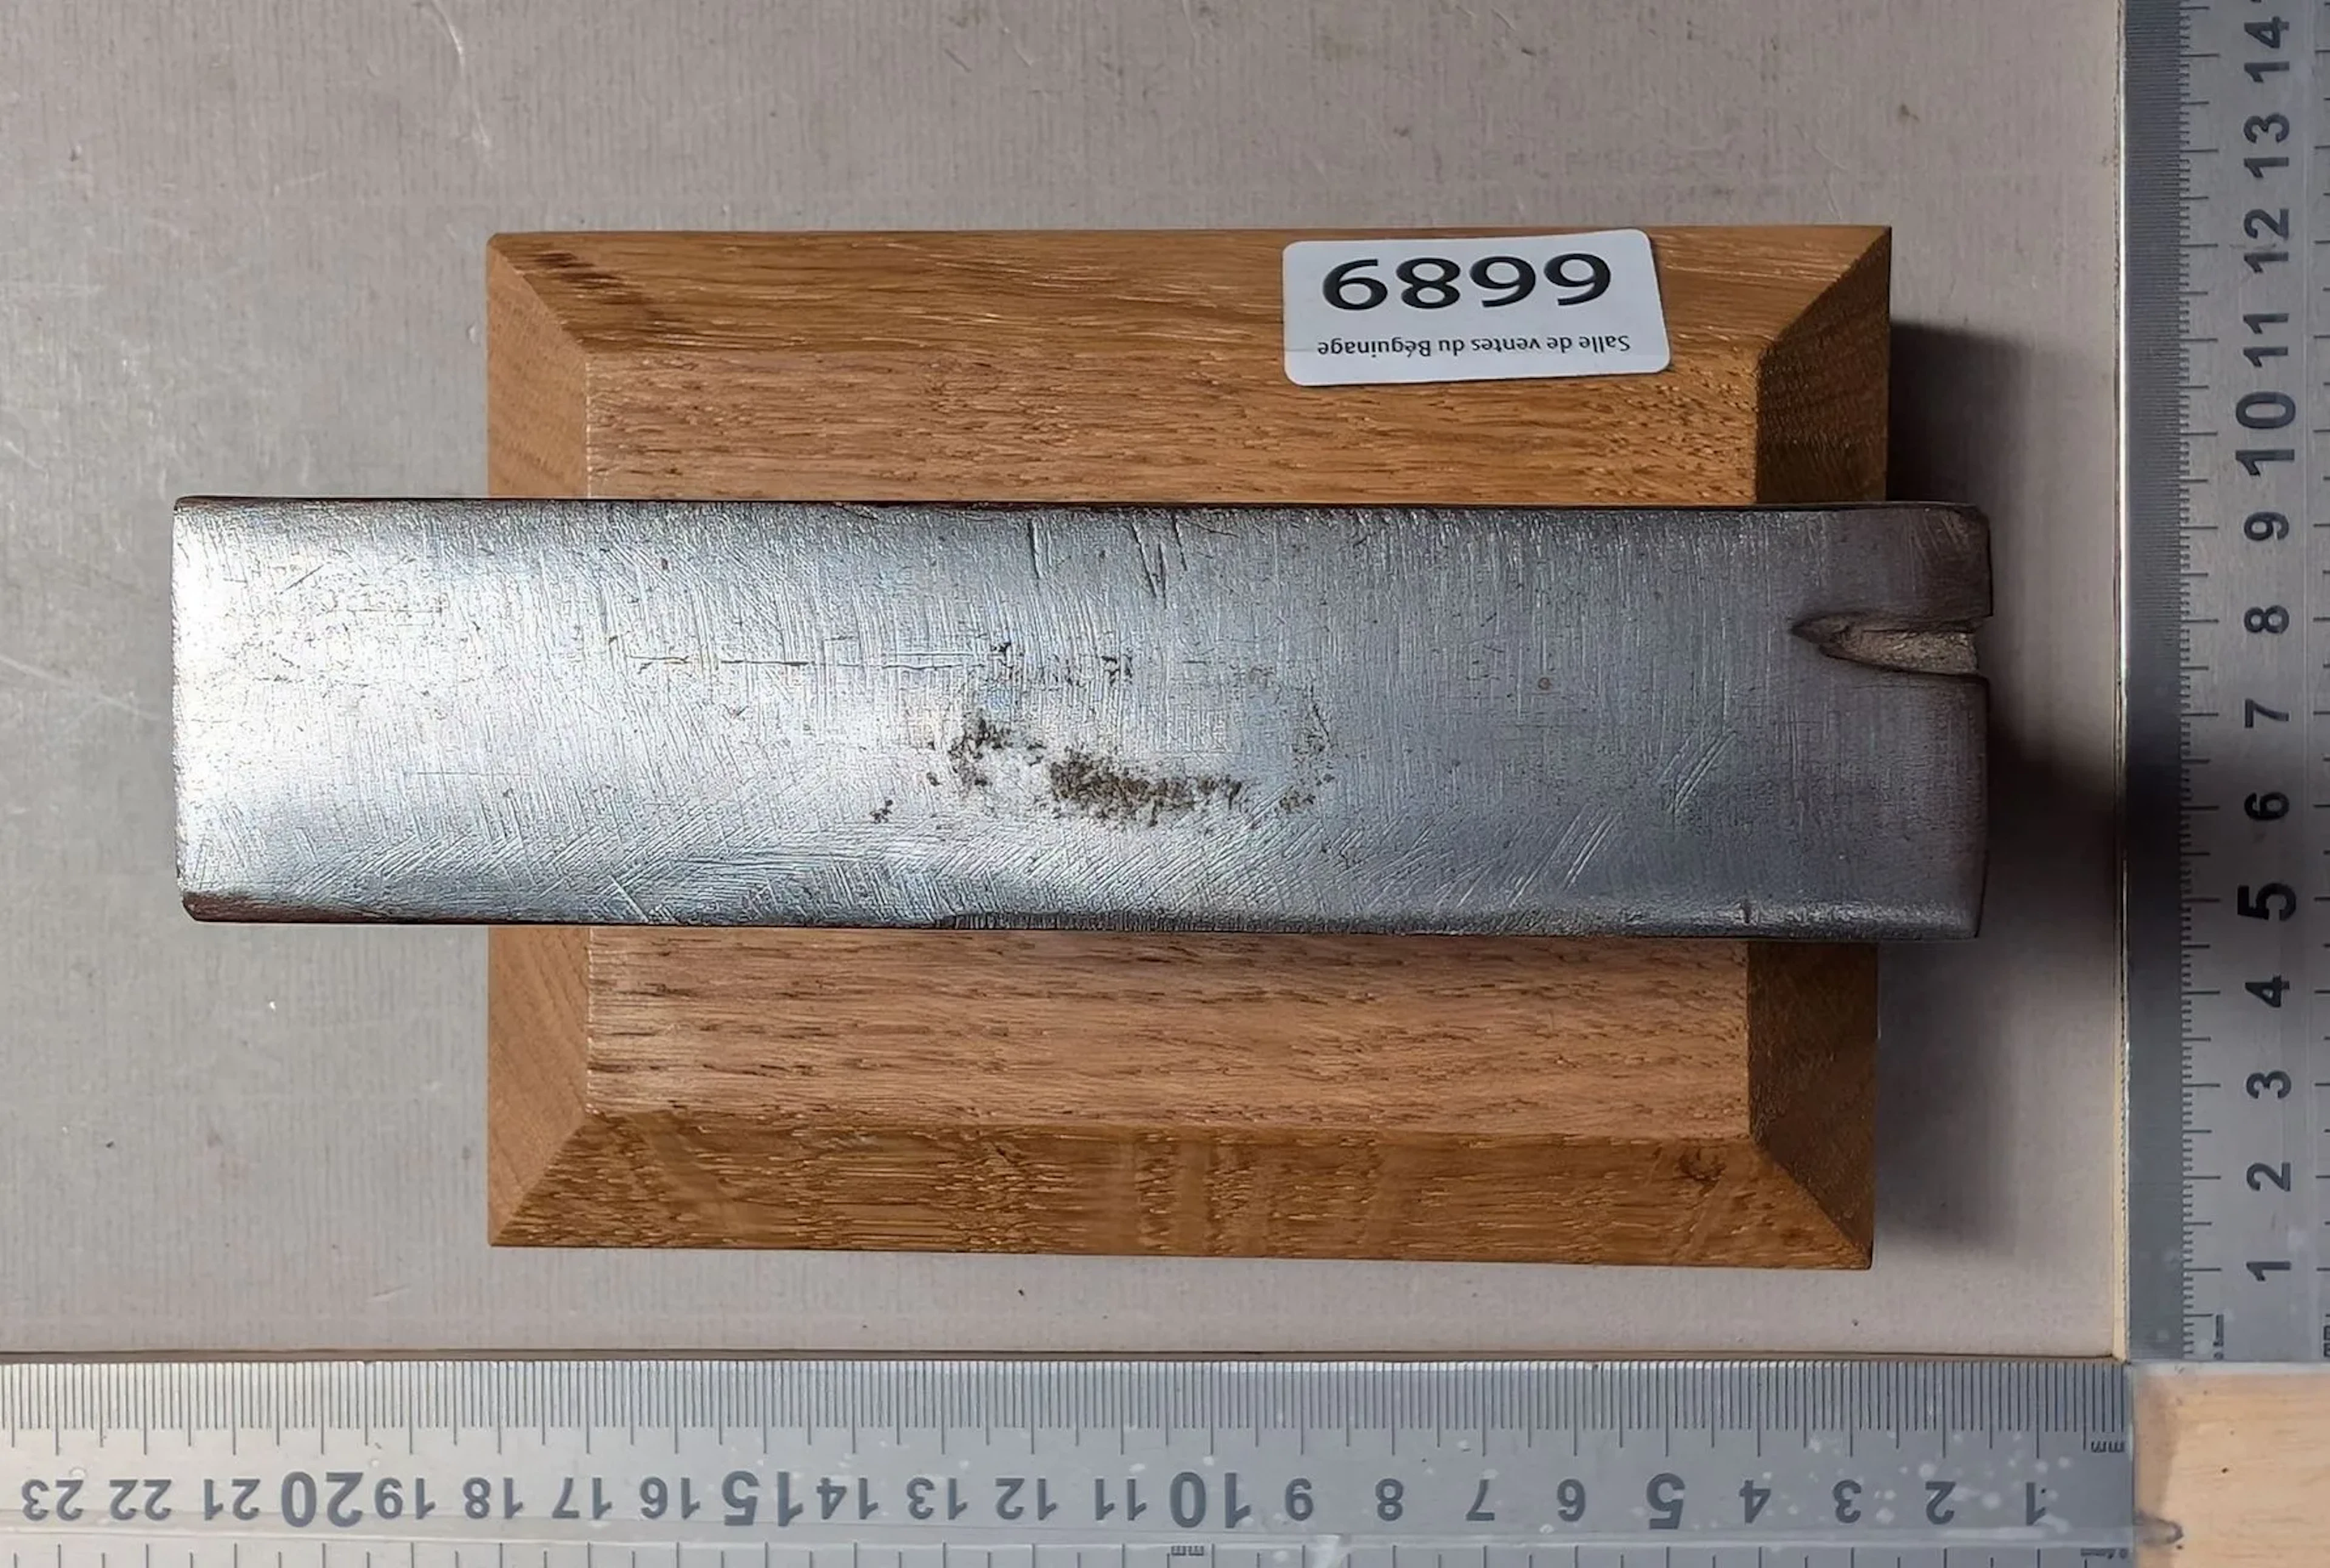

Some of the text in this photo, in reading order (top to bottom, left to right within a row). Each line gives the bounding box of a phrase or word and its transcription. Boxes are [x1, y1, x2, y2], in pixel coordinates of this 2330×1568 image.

[2244, 17, 2288, 83] 14
[2243, 113, 2289, 178] 13
[2244, 209, 2288, 273] 12
[1322, 254, 1611, 311] 6689
[1318, 336, 1630, 357] Salle de ventes du Béguinage
[2243, 312, 2288, 368] 11
[2236, 391, 2295, 476] 10
[2244, 512, 2288, 541] 9
[2244, 606, 2288, 634] 8
[2244, 698, 2289, 729] 7
[2245, 793, 2289, 822] 6
[2238, 885, 2295, 922] 5
[2246, 976, 2289, 1008] 4
[2246, 1070, 2290, 1100] 3
[2247, 1162, 2290, 1192] 2
[2247, 1260, 2289, 1282] 1
[2090, 1441, 2125, 1454] mm
[22, 1479, 83, 1521] 23
[110, 1479, 171, 1521] 22
[202, 1479, 260, 1521] 21
[281, 1472, 362, 1527] 20
[376, 1478, 435, 1519] 19
[464, 1478, 523, 1519] 18
[552, 1478, 612, 1519] 17
[640, 1478, 700, 1519] 16
[722, 1471, 803, 1527] 15
[816, 1478, 878, 1520] 14
[906, 1478, 967, 1520] 13
[996, 1478, 1056, 1520] 12
[1093, 1479, 1147, 1520] 11
[1170, 1472, 1250, 1527] 10
[1285, 1478, 1314, 1521] 9
[1374, 1478, 1403, 1521] 8
[1466, 1479, 1494, 1521] 7
[1558, 1480, 1585, 1522] 6
[1647, 1474, 1685, 1529] 5
[1740, 1481, 1770, 1523] 4
[1834, 1480, 1862, 1524] 3
[1925, 1482, 1955, 1524] 2
[2025, 1482, 2047, 1525] 1
